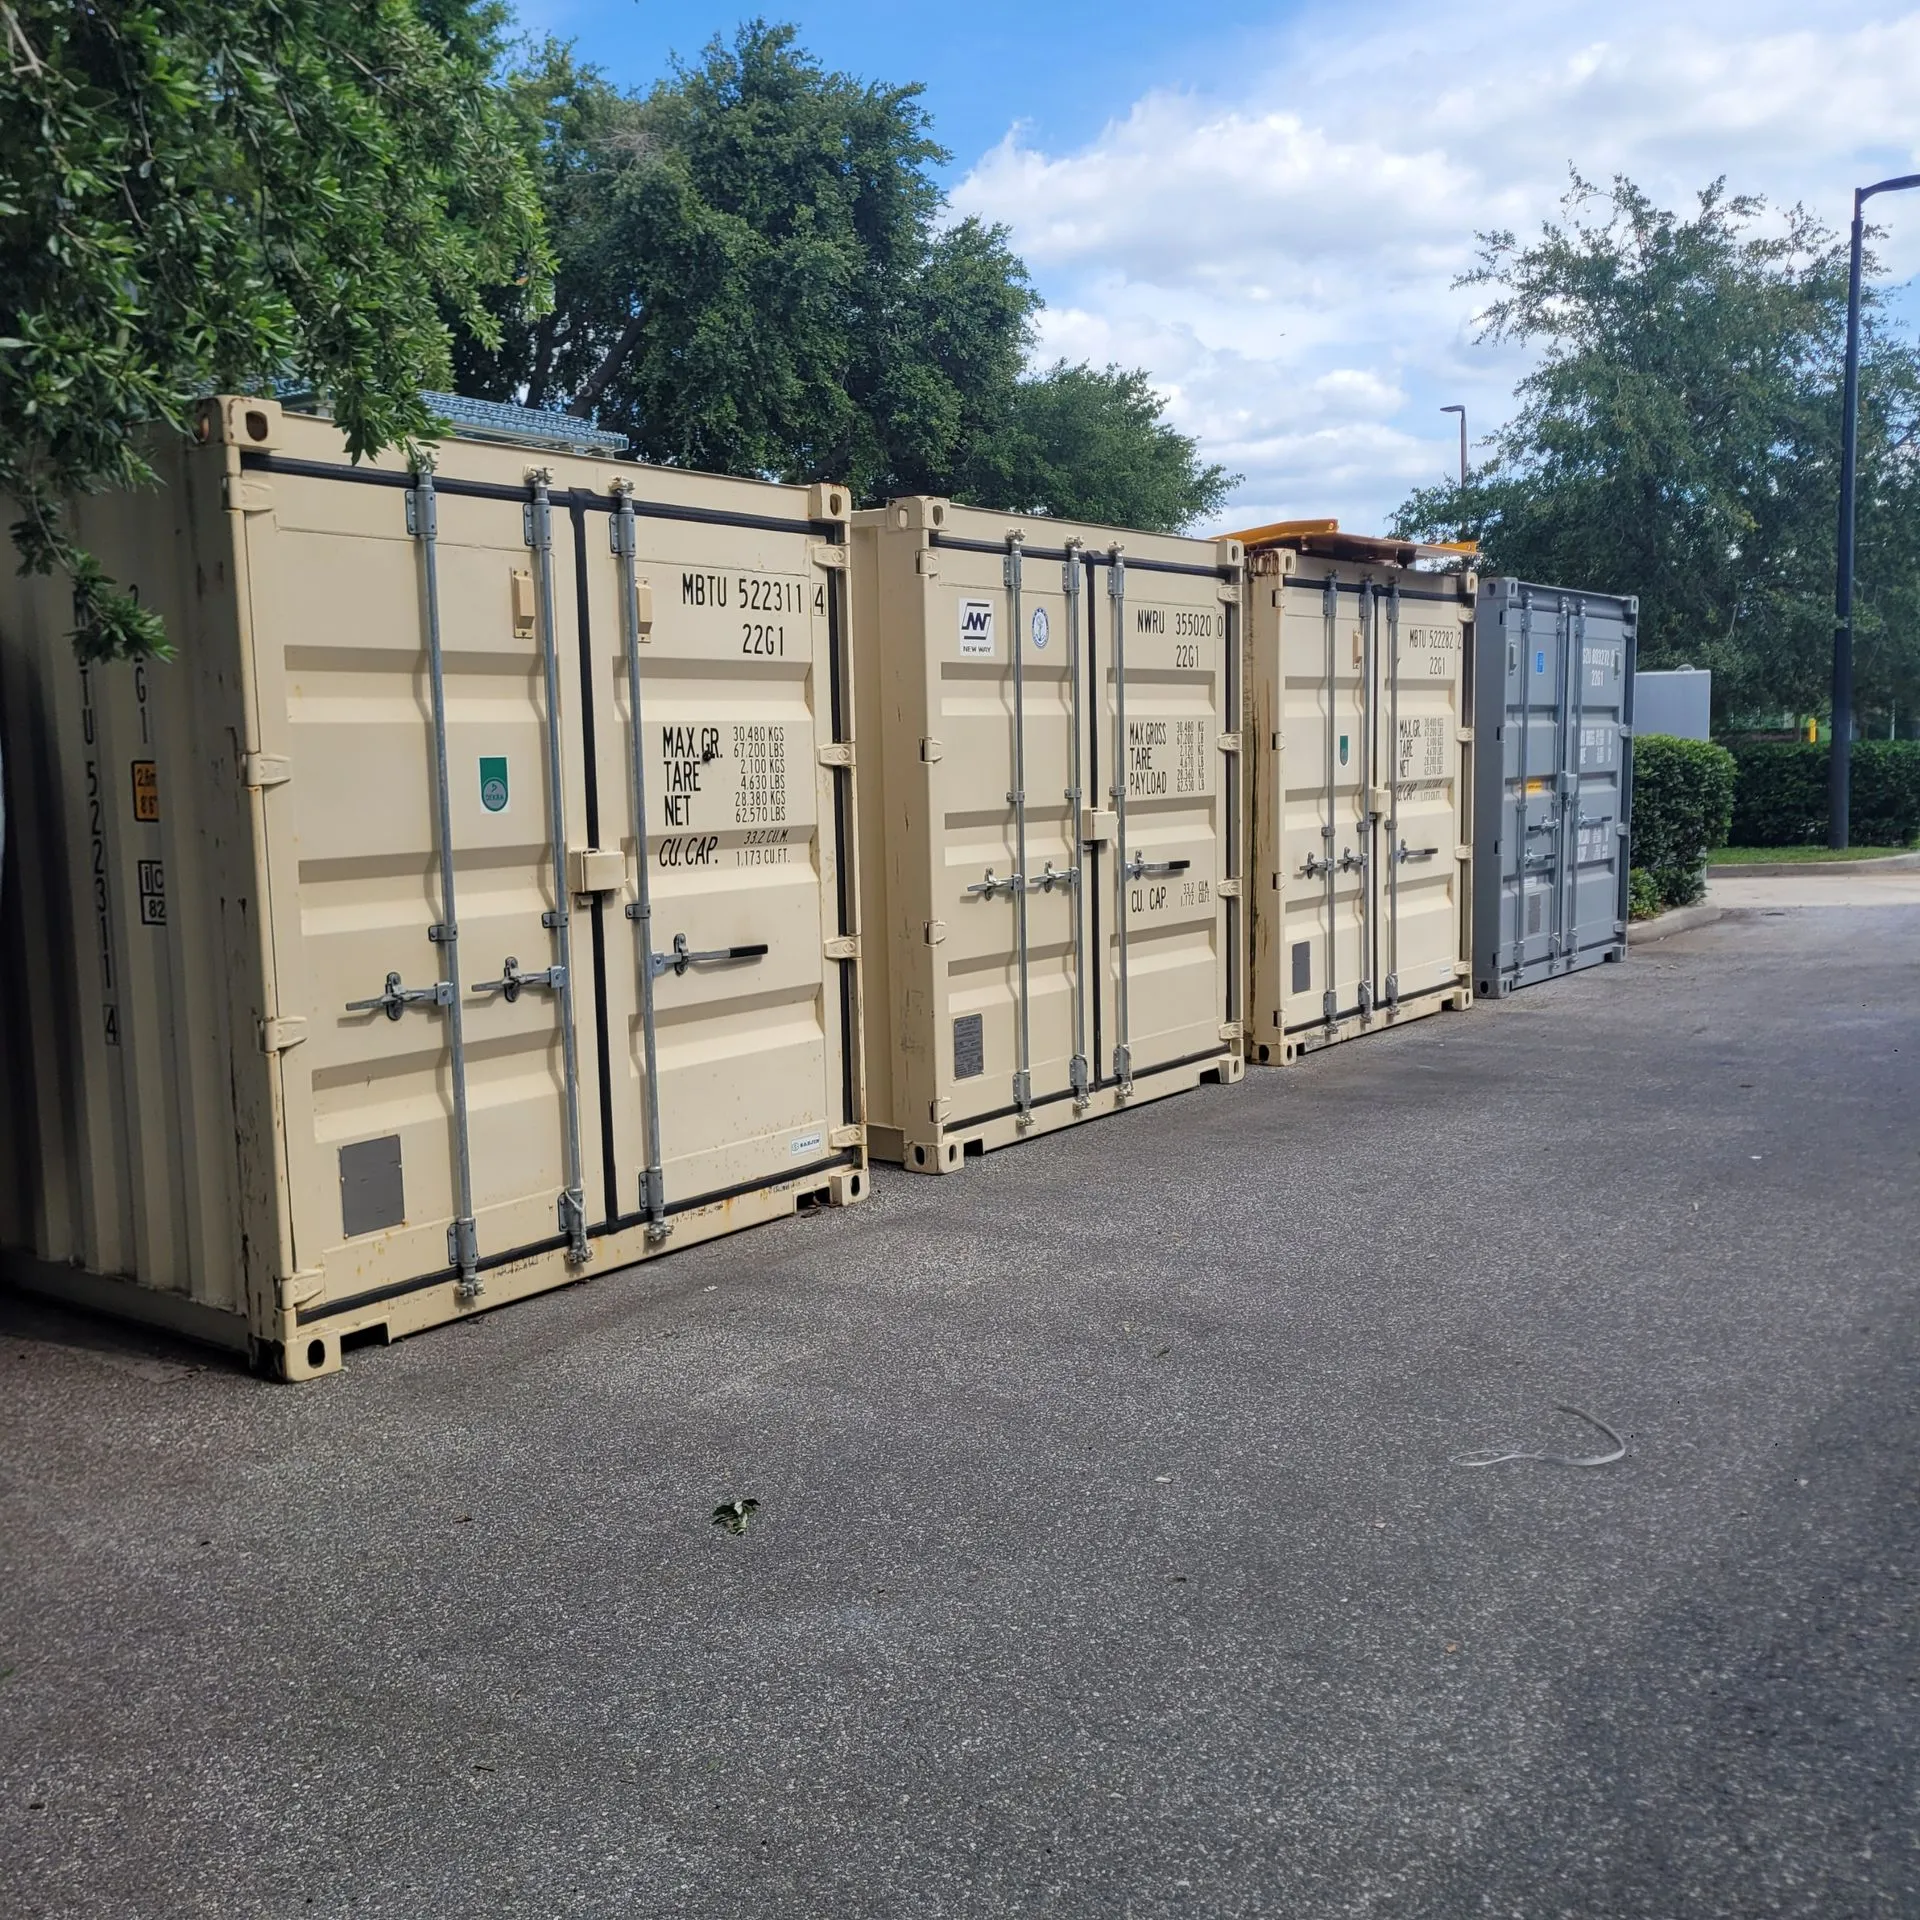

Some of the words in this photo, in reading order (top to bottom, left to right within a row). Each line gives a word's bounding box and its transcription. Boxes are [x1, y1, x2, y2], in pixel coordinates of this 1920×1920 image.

[682, 573, 727, 607] MBTU
[739, 578, 802, 613] 522311
[814, 585, 824, 614] 4
[1138, 609, 1165, 634] NWRU
[1176, 613, 1211, 637] 355020
[1218, 616, 1223, 637] 0
[742, 623, 784, 656] 22G1
[1429, 630, 1453, 649] 522282
[1458, 632, 1461, 649] 2
[1176, 645, 1199, 668] 22G1
[1429, 656, 1445, 676] 22G1
[733, 727, 765, 742] 30.480
[768, 727, 784, 742] KGS
[1130, 722, 1144, 745] MAX
[1146, 722, 1166, 745] GROSS
[734, 743, 765, 758] 67.200
[769, 743, 784, 758] LBS
[1400, 739, 1413, 757] TARE
[1130, 747, 1152, 771] TARE
[1400, 760, 1409, 778] NET
[664, 761, 701, 792] TARE
[740, 759, 767, 774] 2.100
[770, 759, 785, 774] KGS
[741, 775, 767, 790] 4.630
[770, 775, 786, 790] LBS
[1130, 771, 1166, 795] PAYLOAD
[664, 795, 691, 826] NET
[735, 791, 767, 807] 28.380
[771, 790, 786, 805] KGS
[735, 807, 767, 823] 62.570
[771, 806, 786, 822] LBS
[744, 831, 766, 844] 33.2
[736, 850, 761, 867] 1.173
[1132, 889, 1144, 912] CU.
[1149, 886, 1168, 910] CAP.
